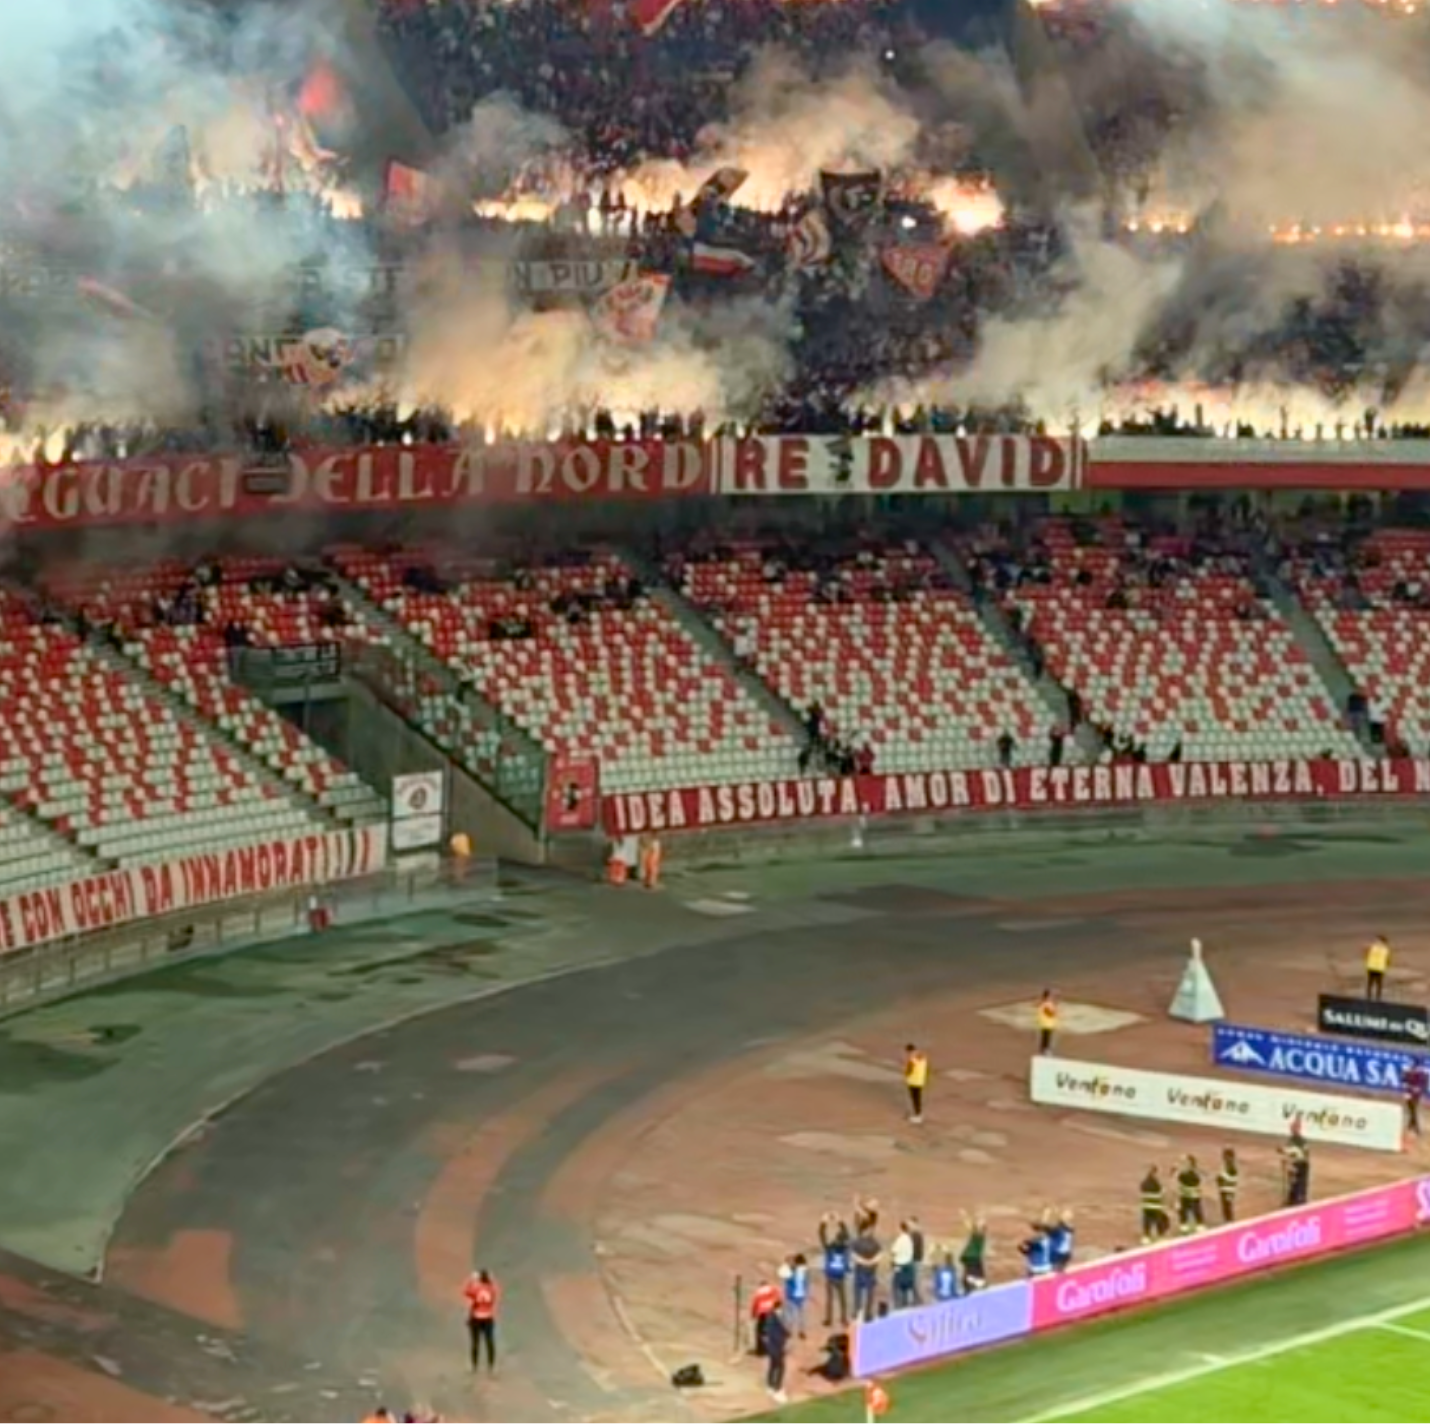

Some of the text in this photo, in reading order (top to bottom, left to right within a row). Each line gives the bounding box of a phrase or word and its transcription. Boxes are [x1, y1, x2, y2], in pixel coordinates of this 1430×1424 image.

[733, 436, 1067, 490] RE DAVID
[615, 790, 686, 830] IDEA
[884, 771, 971, 811] AMOR
[983, 769, 1016, 804] DI
[1029, 765, 1156, 801] ETERNA
[1339, 759, 1399, 792] DEL
[18, 886, 67, 943] CON
[72, 869, 133, 927] OCCHI
[140, 862, 173, 913] DA
[1270, 1046, 1362, 1086] ACQUA
[1056, 1262, 1147, 1313] Garofoli
[1237, 1216, 1321, 1263] Garofoli
